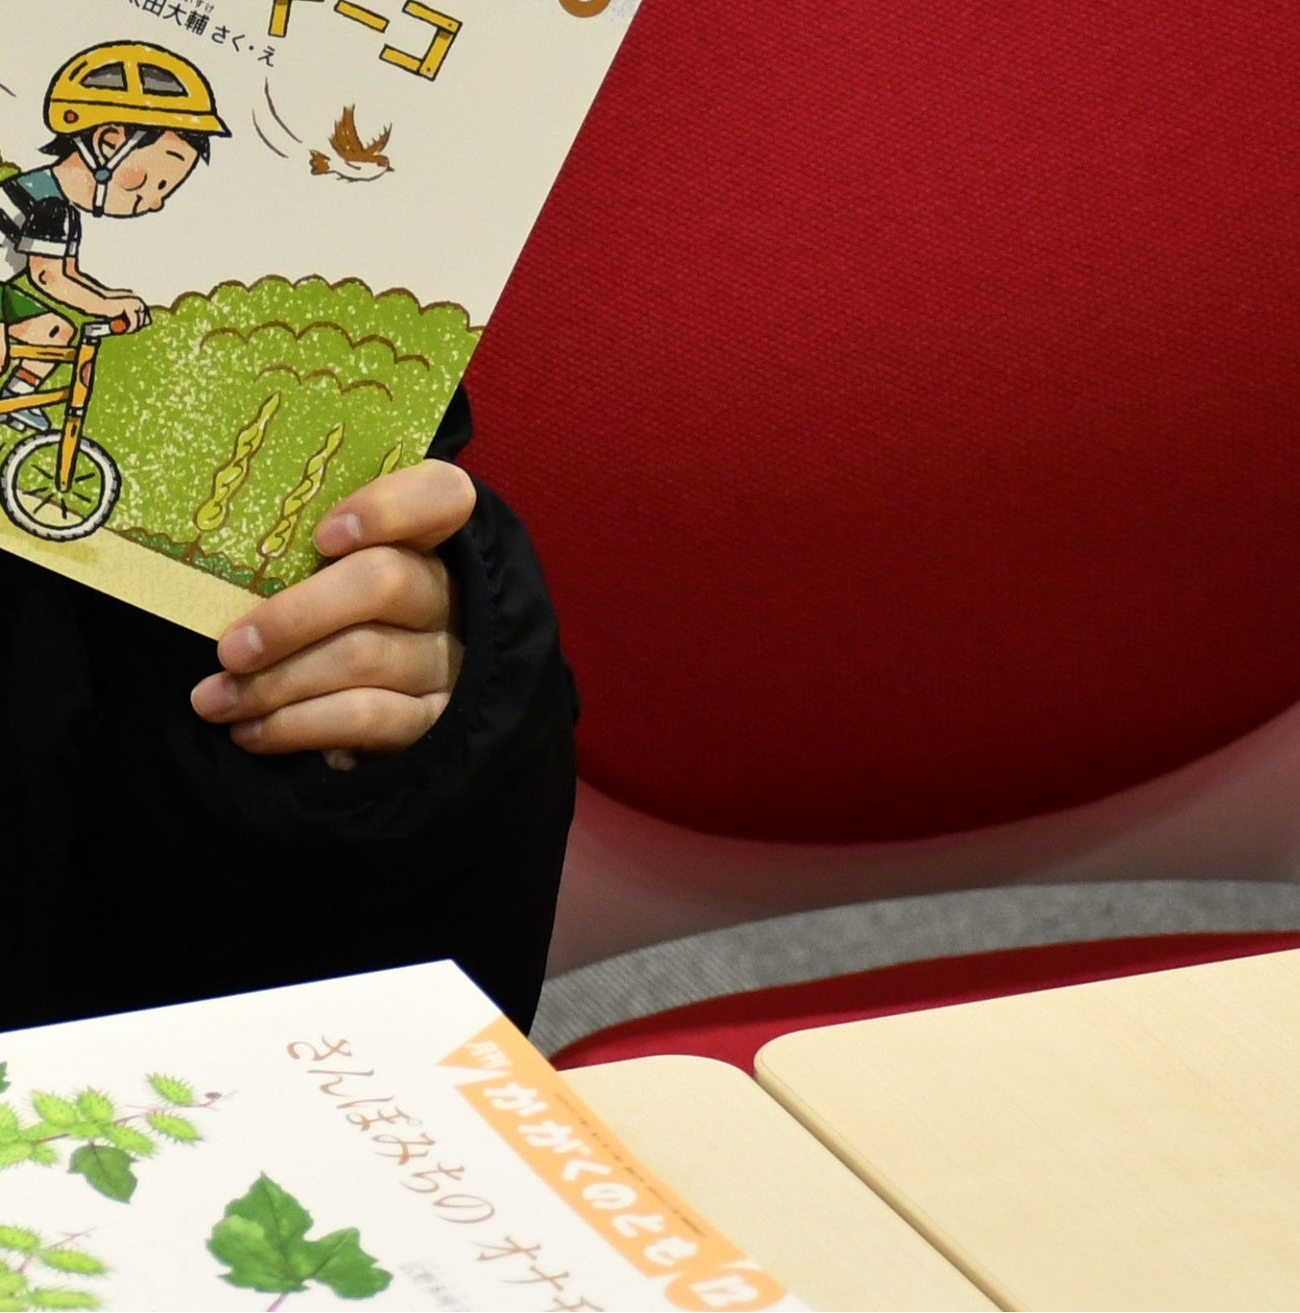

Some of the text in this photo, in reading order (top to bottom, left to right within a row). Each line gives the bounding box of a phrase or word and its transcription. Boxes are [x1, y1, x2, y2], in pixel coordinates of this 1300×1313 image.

[286, 1035, 496, 1225] さんぽみちの
[483, 1081, 700, 1267] かがくのとも
